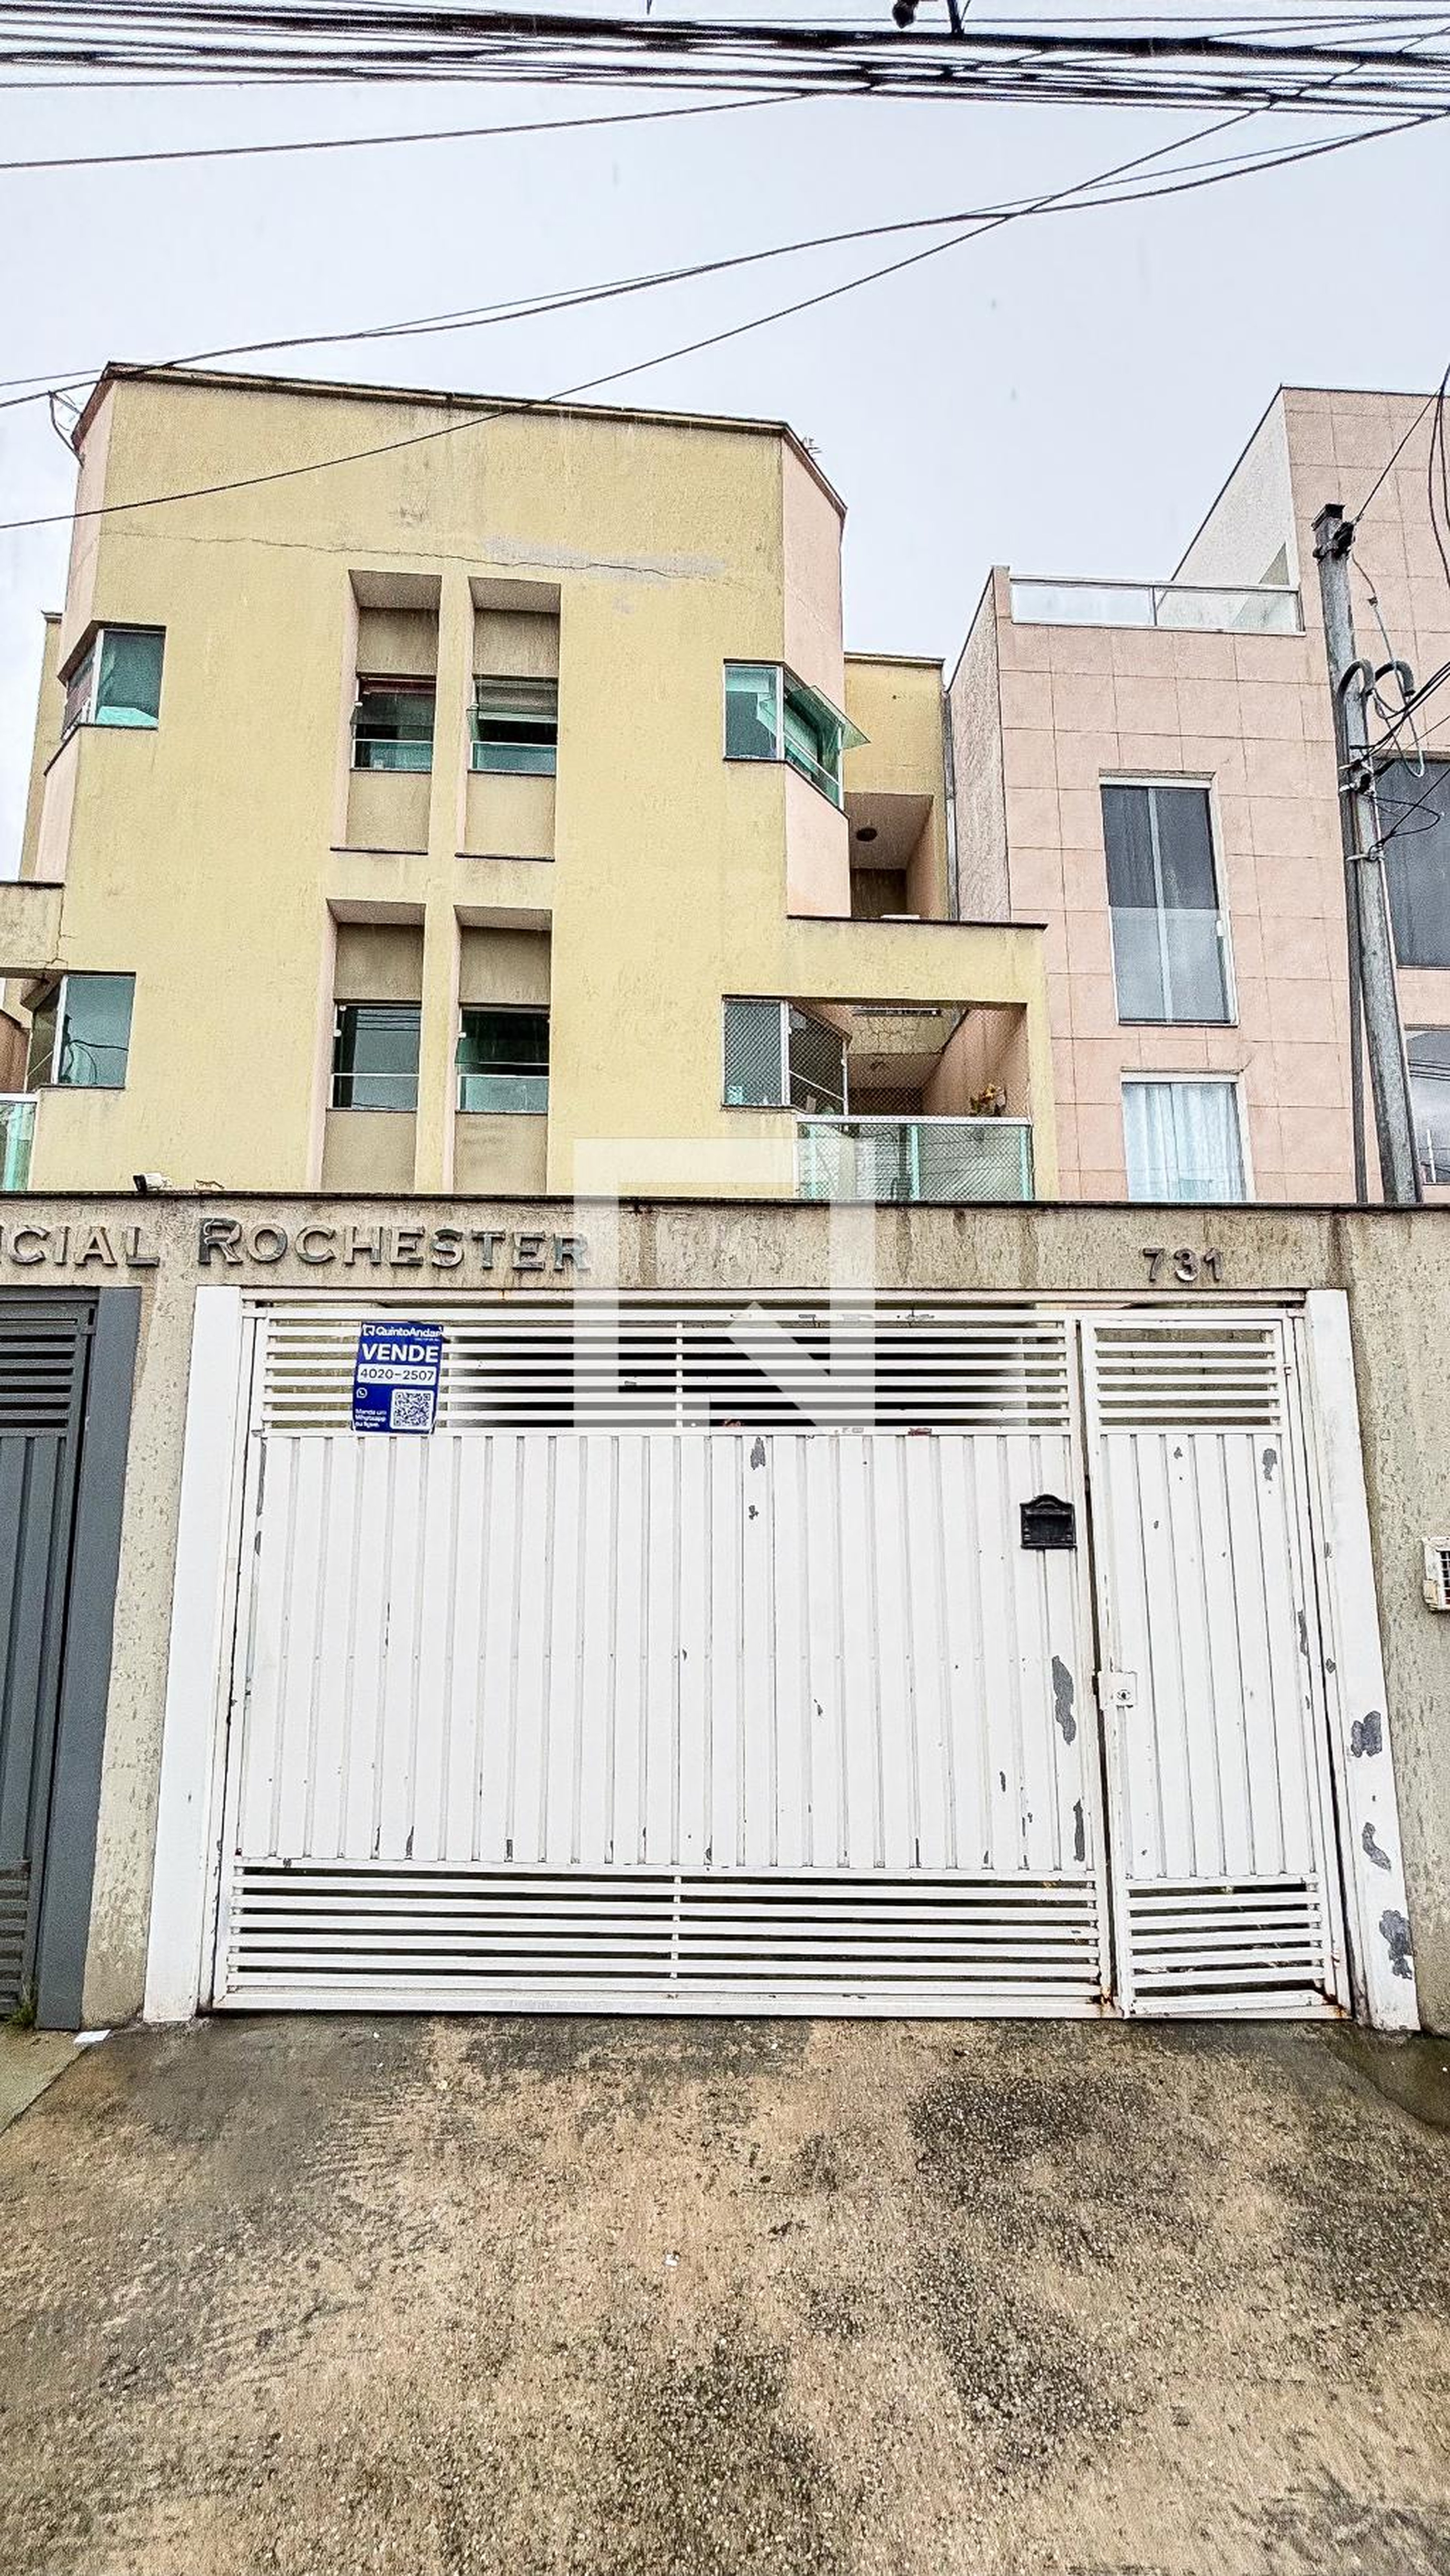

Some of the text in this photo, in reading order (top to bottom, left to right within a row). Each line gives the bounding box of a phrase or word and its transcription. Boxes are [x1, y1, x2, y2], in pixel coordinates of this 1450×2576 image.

[0, 1217, 591, 1270] CIAL ROCHESTER
[1143, 1247, 1223, 1282] 731
[376, 1326, 442, 1337] QuintoAndar
[362, 1343, 439, 1363] VENDE
[361, 1369, 434, 1381] 4020-2507
